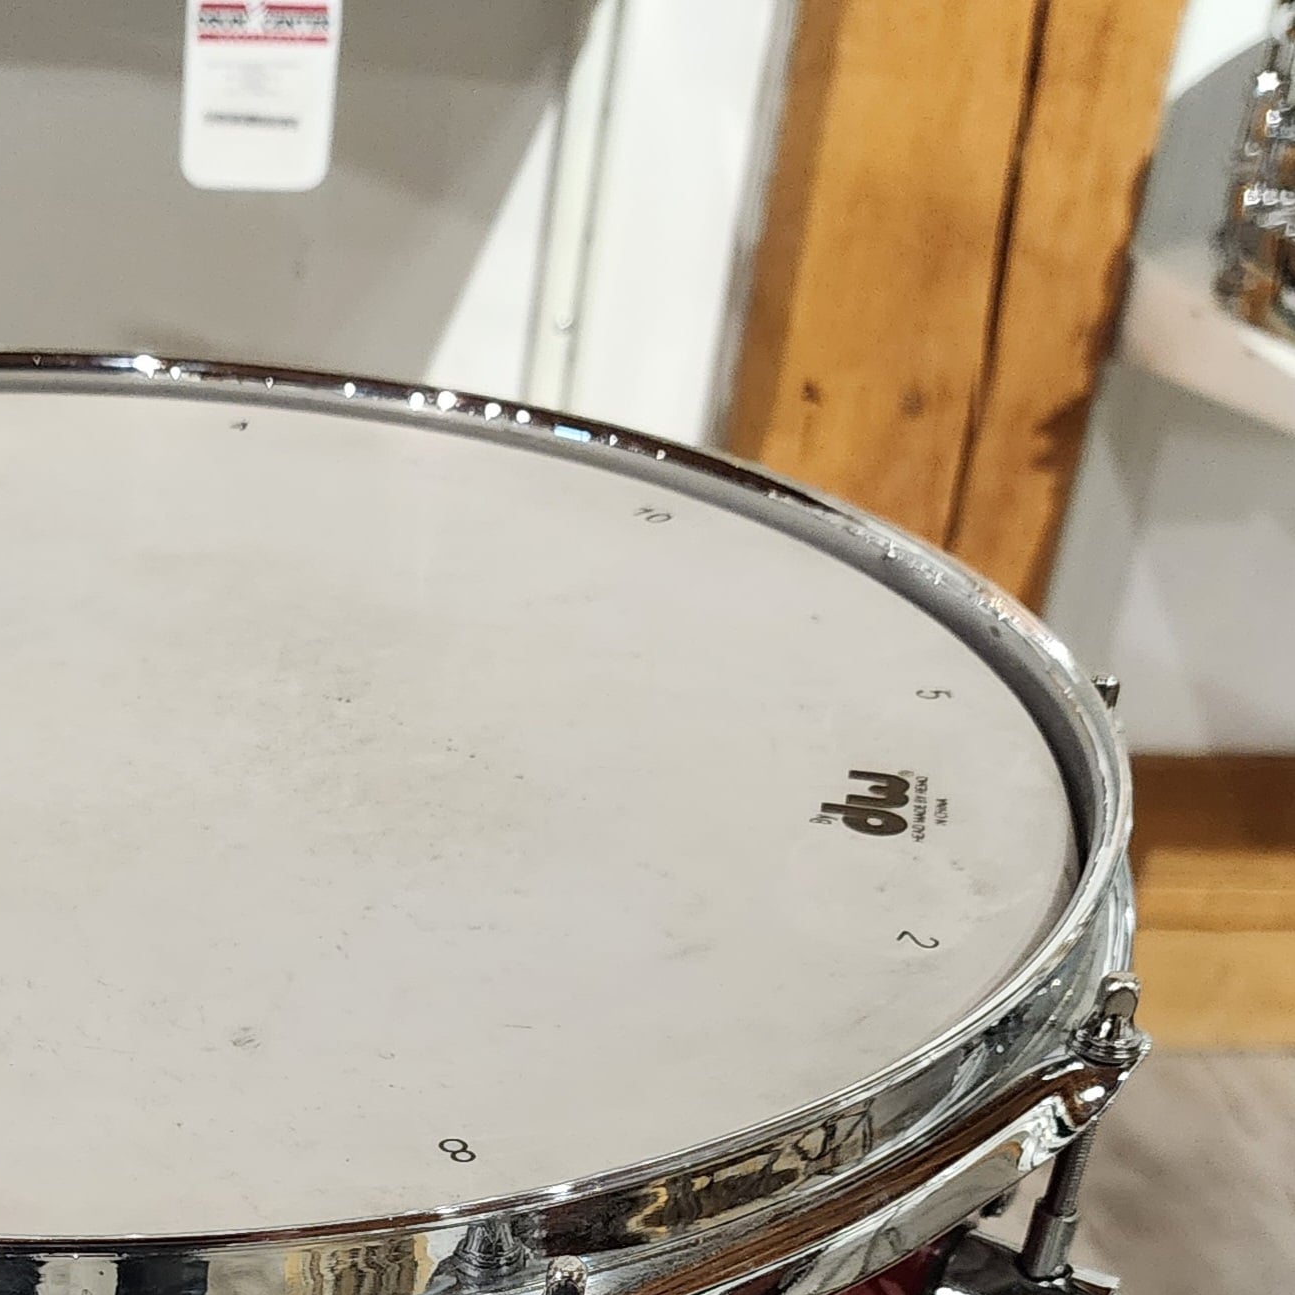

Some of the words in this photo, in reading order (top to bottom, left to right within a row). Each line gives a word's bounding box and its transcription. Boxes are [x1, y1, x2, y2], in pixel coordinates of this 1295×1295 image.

[819, 769, 911, 837] dw
[896, 929, 940, 950] 2
[438, 1138, 477, 1163] 8
